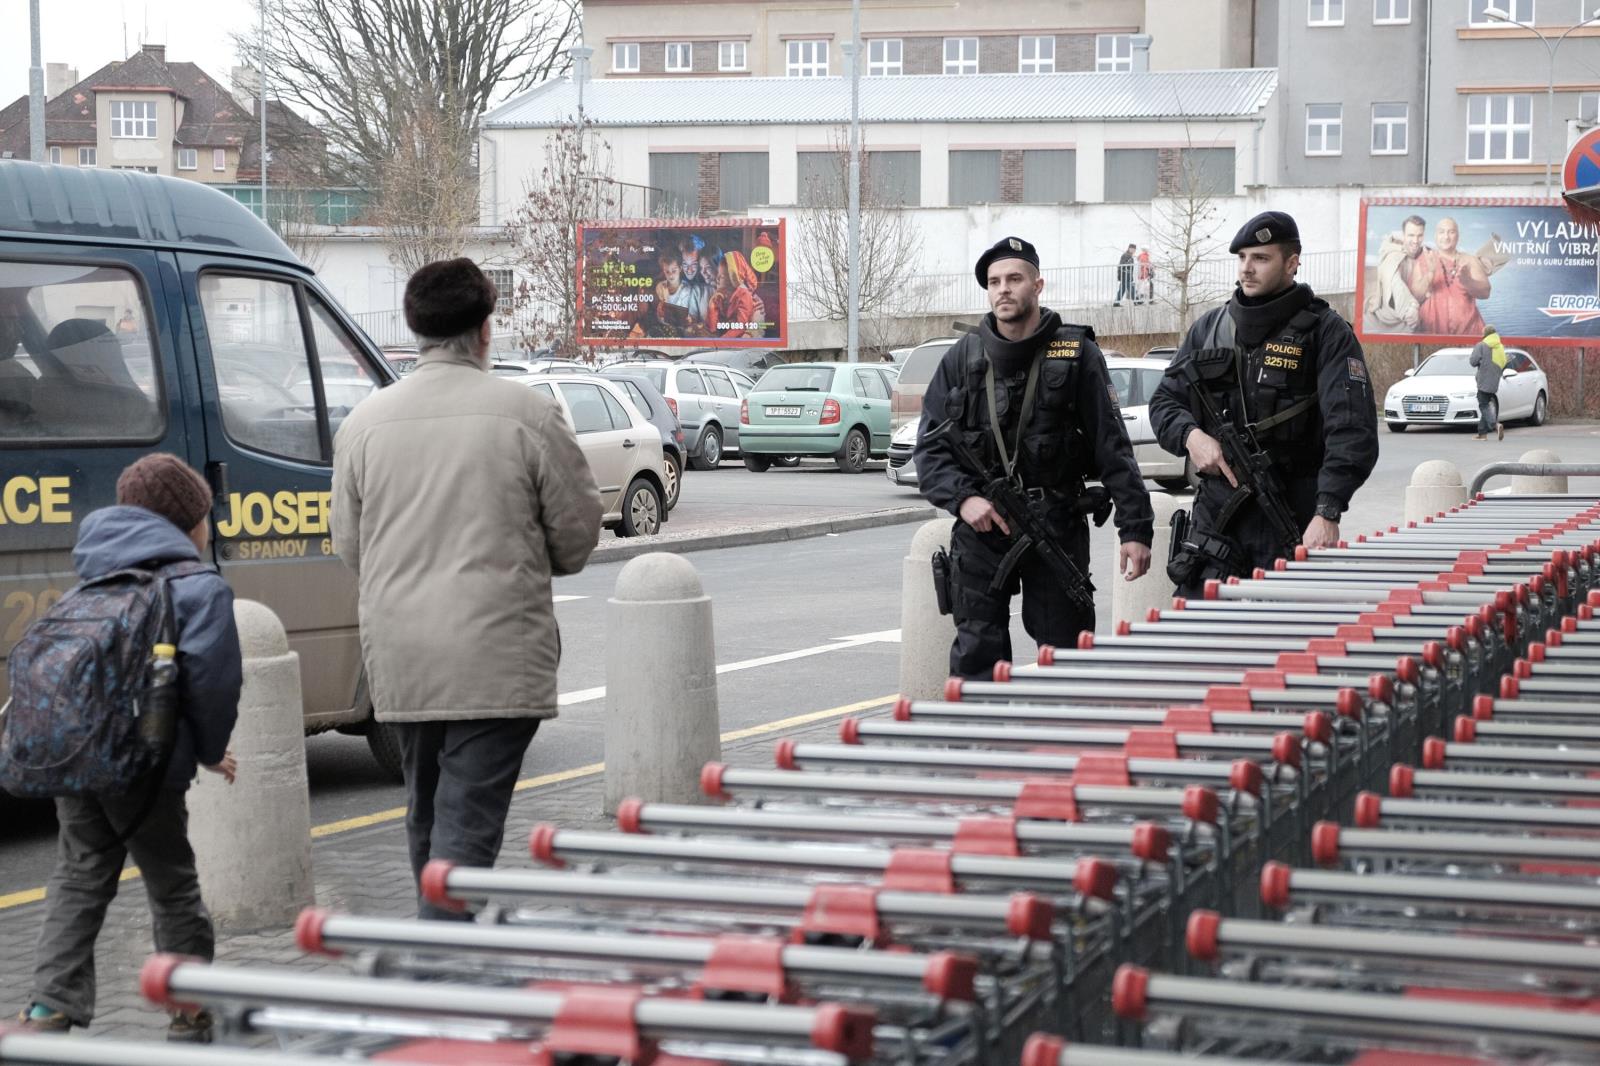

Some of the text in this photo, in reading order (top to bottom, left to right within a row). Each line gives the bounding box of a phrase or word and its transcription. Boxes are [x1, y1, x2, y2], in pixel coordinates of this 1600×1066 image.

[1493, 239, 1550, 255] VNITŘNÍ
[1543, 258, 1562, 266] GURU
[1564, 257, 1595, 267] ČESKÉHO
[1049, 340, 1080, 348] OLICIE
[1265, 343, 1303, 356] POLICIE
[1046, 349, 1075, 358] 324169
[1263, 356, 1299, 370] 325115
[0, 476, 72, 525] CE
[239, 538, 307, 560] SPANOV
